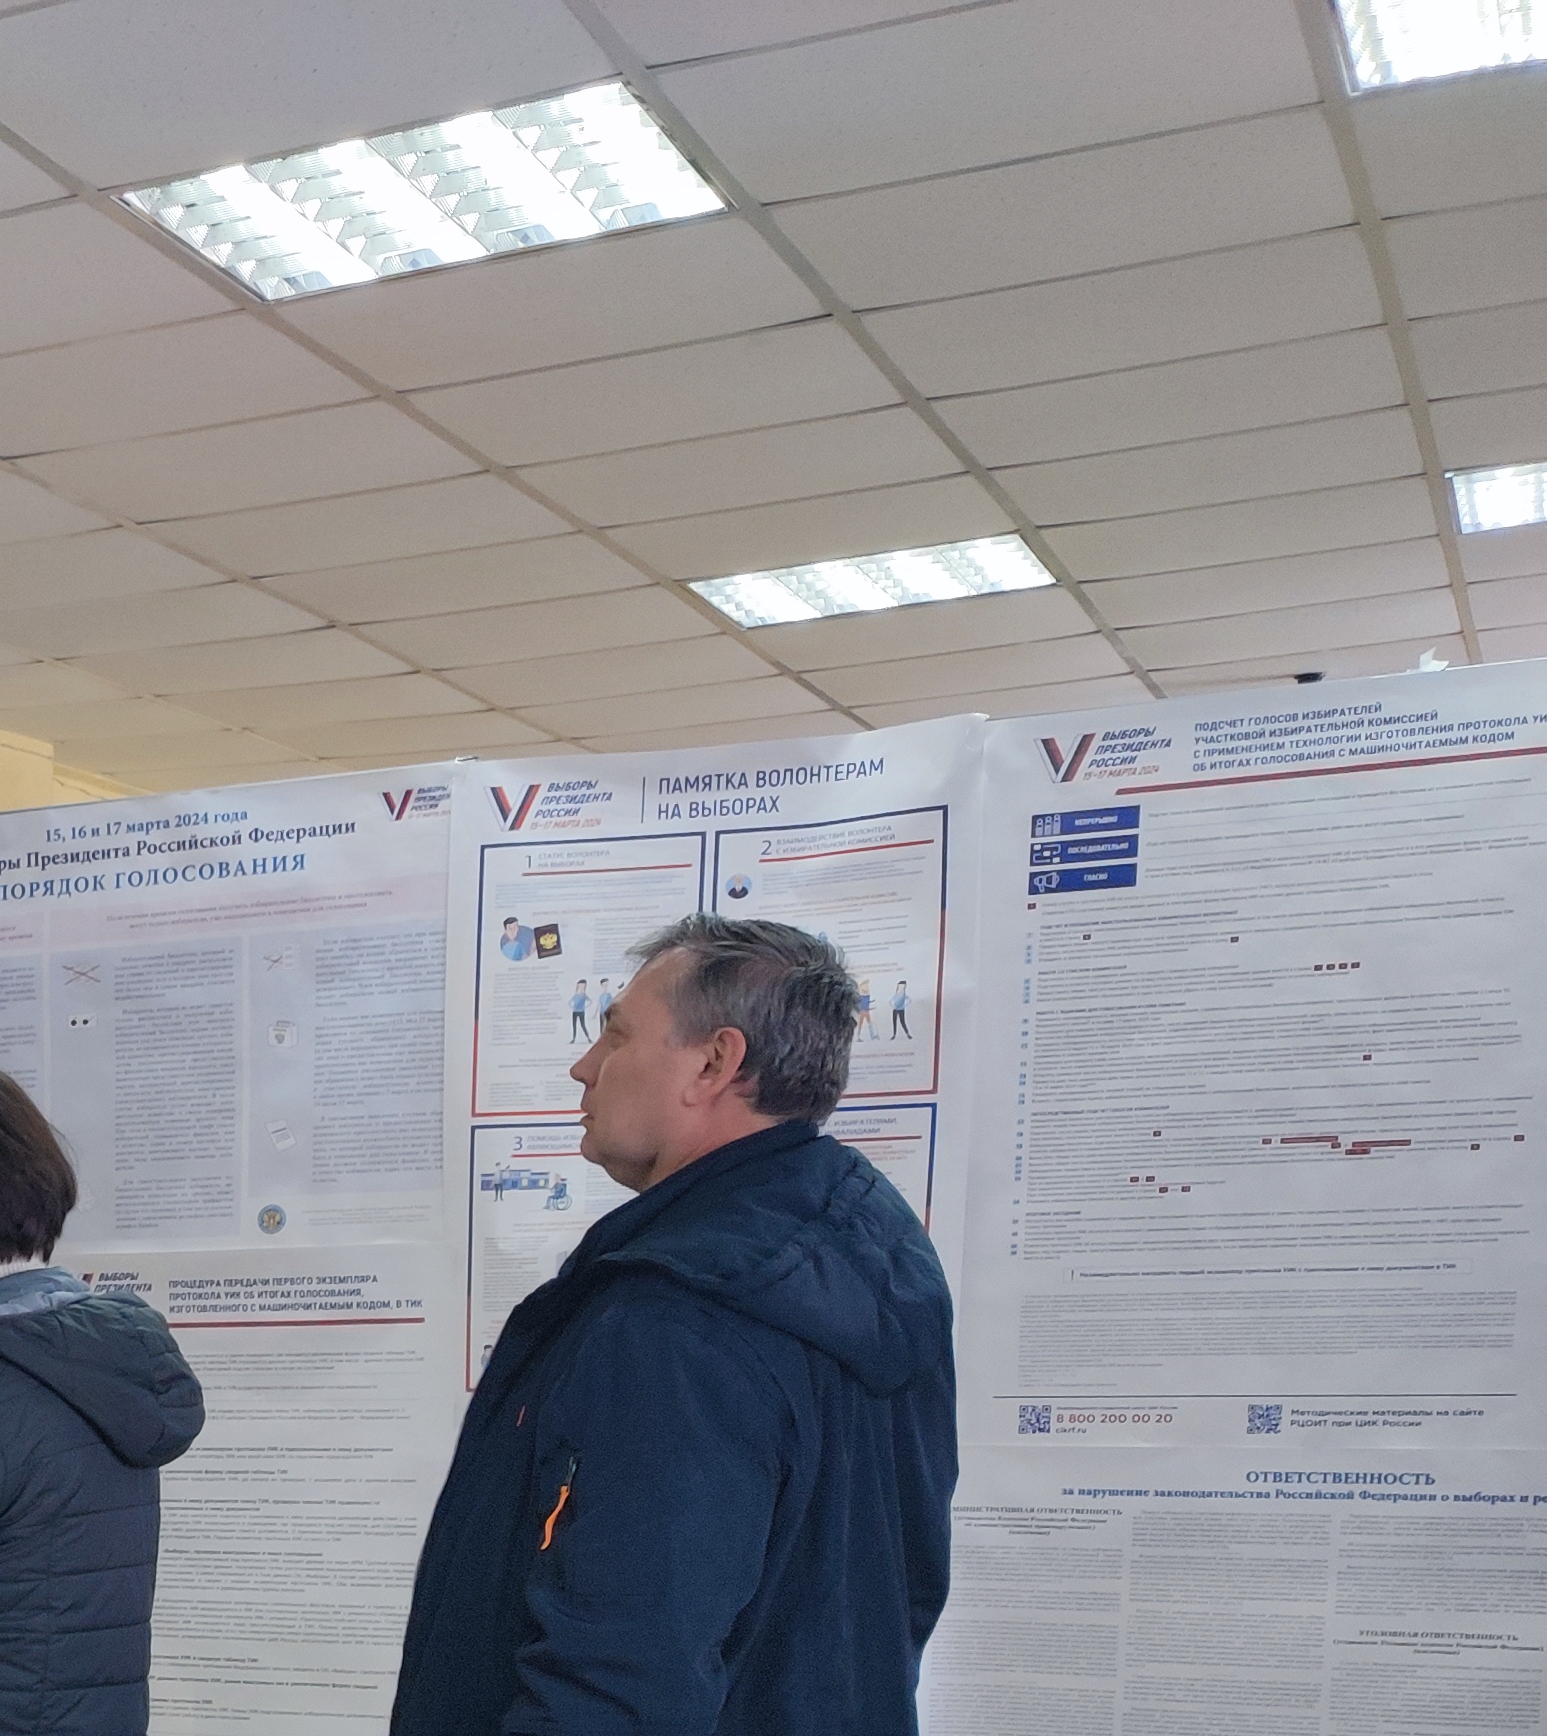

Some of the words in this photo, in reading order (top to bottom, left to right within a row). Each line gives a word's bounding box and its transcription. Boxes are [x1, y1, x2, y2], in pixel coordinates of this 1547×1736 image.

[1194, 718, 1245, 732] ПОДСЧЕТ
[1248, 712, 1299, 727] ГОЛОСОВ
[1302, 702, 1382, 720] ИЗБИРАТЕЛЕЙ
[1101, 726, 1157, 742] ВЫБОРЫ
[1194, 726, 1266, 745] УЧАСТКОВОЙ
[1269, 718, 1364, 739] ИЗБИРАТЕЛЬНОЙ
[1368, 709, 1438, 727] КОМИССИЕЙ
[1203, 741, 1285, 757] ПРИМЕНЕНИЕМ
[1289, 732, 1362, 749] ТЕХНОЛОГИИ
[1364, 723, 1453, 741] ИЗГОТОВЛЕНИЯ
[1457, 716, 1528, 731] ПРОТОКОЛА
[1094, 738, 1173, 756] ПРЕЗИДЕНТА
[1192, 761, 1207, 772] ОБ
[1209, 757, 1251, 771] ИТОГАХ
[1254, 748, 1335, 766] ГОЛОСОВАНИЯ
[1348, 735, 1468, 756] МАШИНОЧИТАЕМЫМ
[1472, 731, 1515, 744] КОДОМ
[1088, 755, 1138, 769] РОССИИ
[658, 774, 749, 796] ПАМЯТКА
[754, 757, 885, 790] ВОЛОНТЕРАМ
[546, 779, 599, 793] ВЫБОРЫ
[540, 790, 613, 807] ПРЕЗИДЕНТА
[534, 804, 581, 819] РОССИИ
[657, 802, 684, 820] НА
[688, 795, 780, 819] ВЫБОРАХ
[45, 828, 66, 845] 15,
[71, 824, 87, 841] 16
[90, 827, 100, 838] и
[107, 821, 122, 837] 17
[125, 817, 171, 836] марта
[174, 811, 209, 829] 2024
[213, 809, 248, 825] года
[26, 843, 131, 871] Президента
[136, 829, 242, 857] Российской
[248, 820, 357, 845] Федерации
[761, 839, 773, 856] 2
[525, 854, 533, 869] 1
[114, 853, 306, 890] ГОЛОСОВАНИЯ
[512, 1135, 523, 1151] 3
[99, 1271, 139, 1281] ВЫБОРЫ
[169, 1278, 222, 1289] ПРОЦЕДУРА
[223, 1277, 271, 1288] ПЕРЕДАЧИ
[272, 1276, 314, 1287] ПЕРВОГО
[316, 1274, 378, 1285] ЭКЗЕМПЛЯРА
[169, 1289, 223, 1301] ПРОТОКОЛА
[225, 1291, 242, 1300] УИК
[243, 1290, 255, 1299] ОБ
[257, 1289, 292, 1299] ИТОГАХ
[294, 1287, 365, 1299] ГОЛОСОВАНИЯ,
[169, 1303, 249, 1314] ИЗГОТОВЛЕННОГО
[250, 1303, 257, 1313] С
[258, 1301, 354, 1312] МАШИНОЧИТАЕМЫМ
[357, 1300, 394, 1311] КОДОМ,
[405, 1299, 423, 1309] ТИК
[1057, 1414, 1064, 1424] 8
[1069, 1413, 1096, 1424] 800
[1100, 1413, 1127, 1424] 200
[1131, 1413, 1151, 1424] 00
[1155, 1413, 1173, 1424] 20
[1290, 1408, 1369, 1418] Методические
[1372, 1409, 1433, 1419] материалы
[1452, 1408, 1485, 1417] сайте
[1331, 1420, 1352, 1428] при
[1355, 1418, 1378, 1428] ЦИК
[1382, 1418, 1423, 1427] России
[1245, 1470, 1436, 1486] ОТВЕТСТВЕННОСТЬ
[1061, 1488, 1074, 1496] за
[1078, 1487, 1150, 1500] нарушение
[1152, 1488, 1272, 1501] законодательства
[1275, 1488, 1356, 1502] Российской
[1358, 1489, 1438, 1504] Федерации
[1453, 1491, 1515, 1505] выборах
